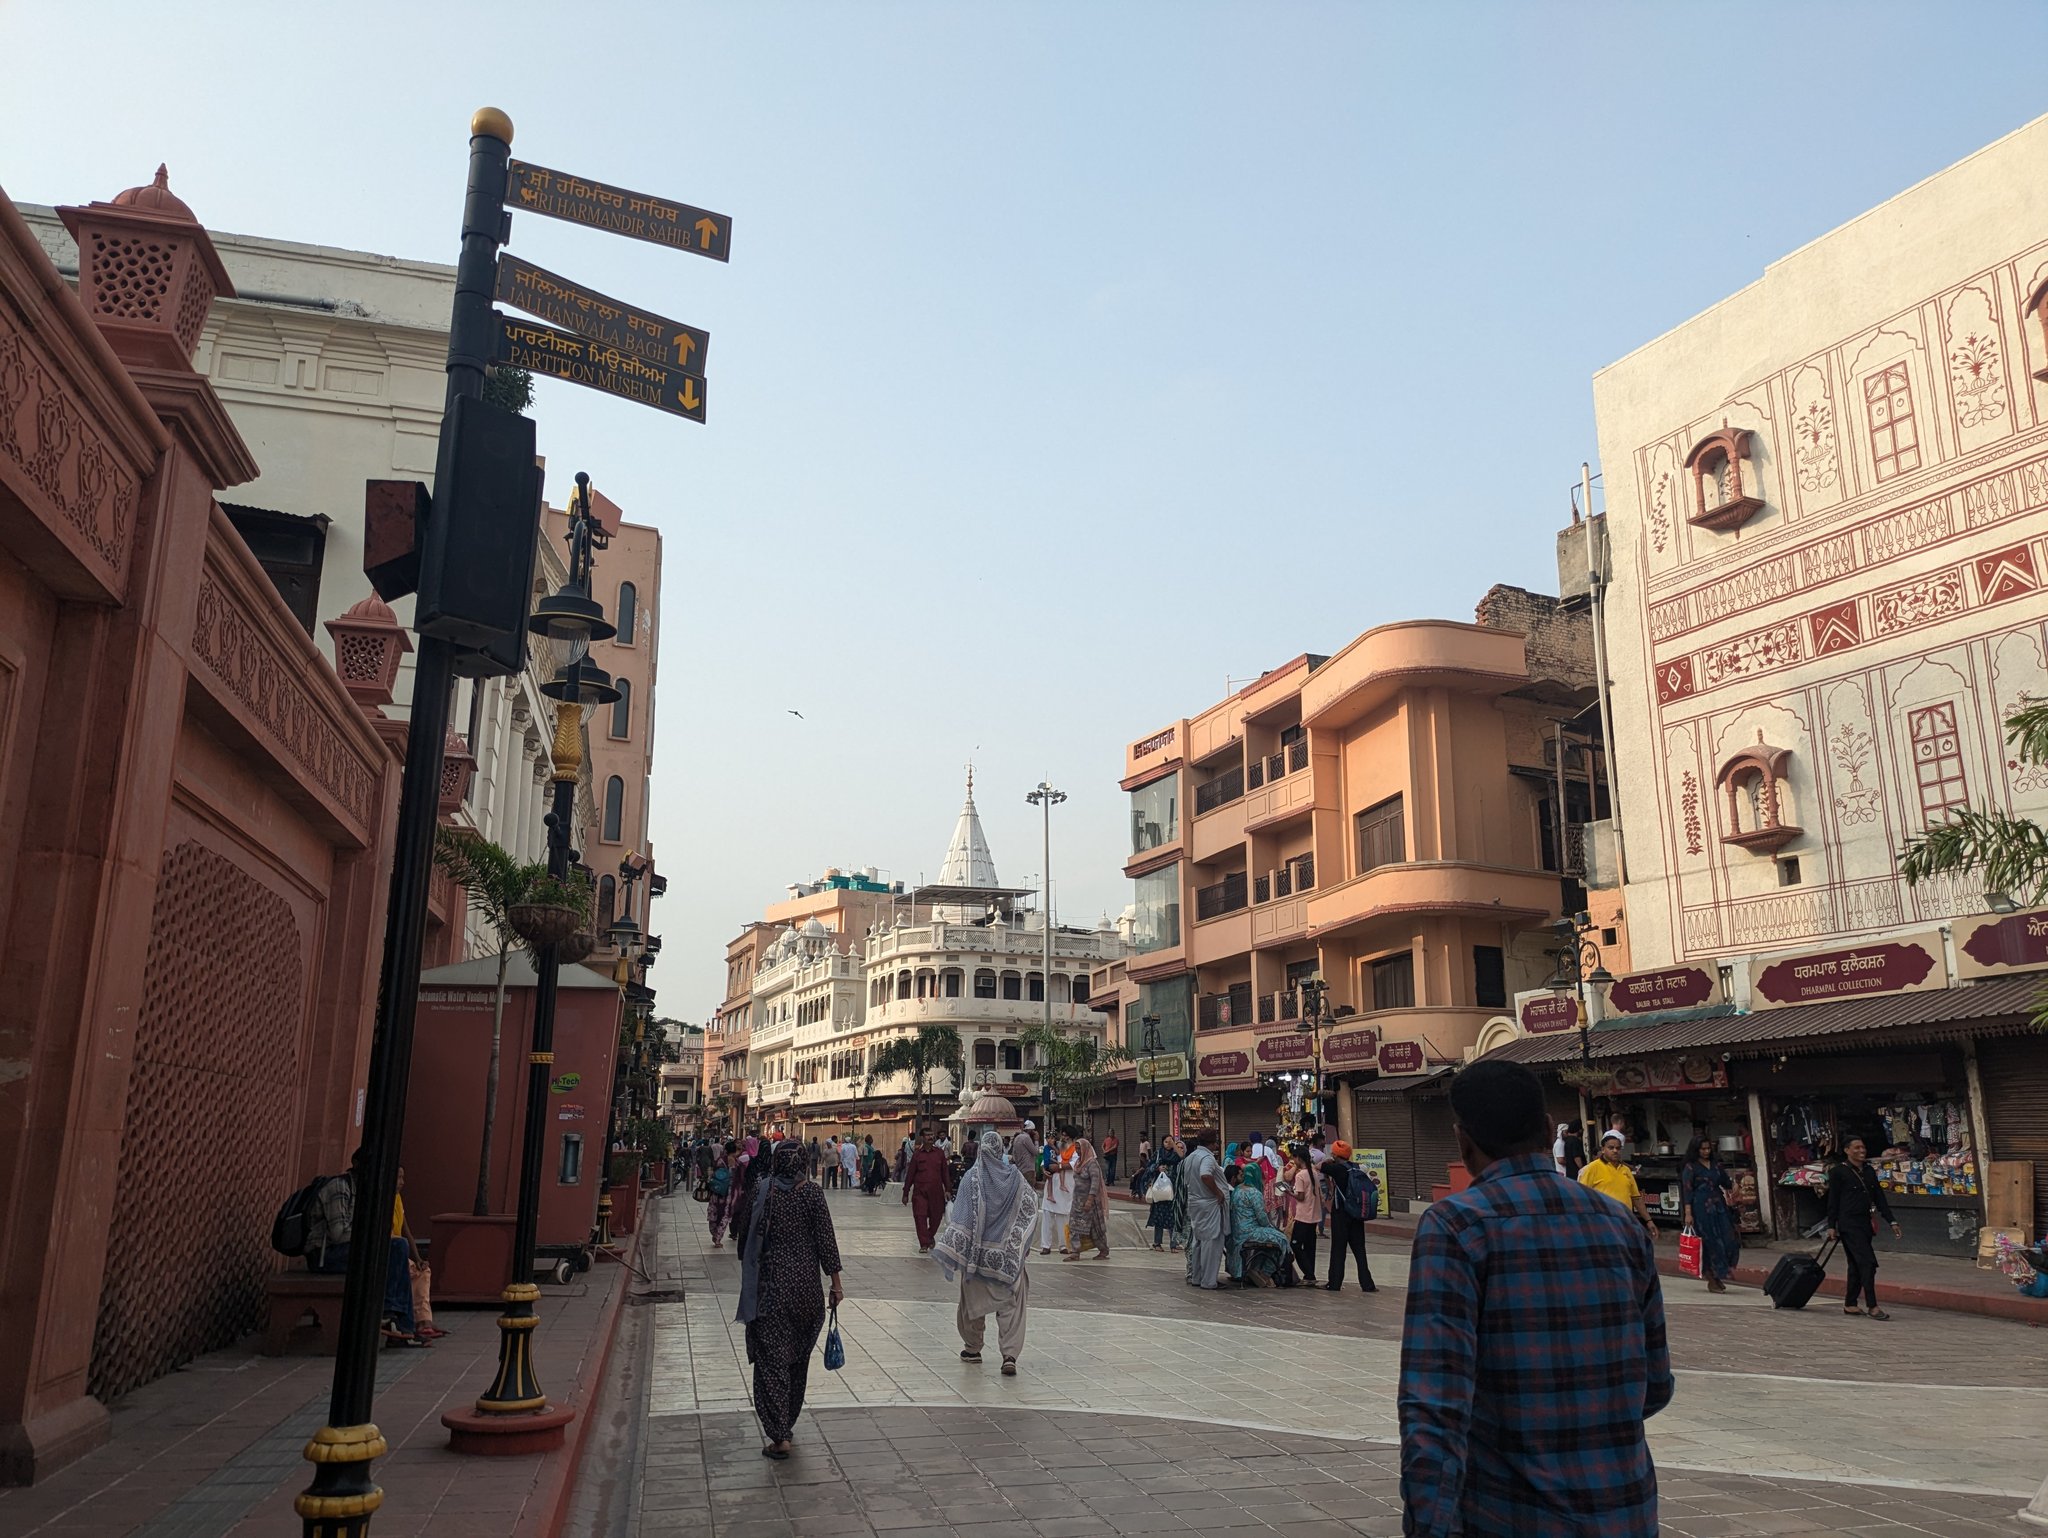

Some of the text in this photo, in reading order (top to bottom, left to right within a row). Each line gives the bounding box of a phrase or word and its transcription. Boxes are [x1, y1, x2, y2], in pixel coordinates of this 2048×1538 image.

[557, 178, 625, 209] ਹਰਿਮੰਦਰ
[629, 199, 680, 223] ਸਾਹਿਬ
[557, 197, 645, 235] HARMANDIR
[649, 222, 691, 246] SAHIB
[508, 287, 668, 362] JALLIANWALA BAGH
[627, 314, 664, 339] ਬਾਗ
[505, 325, 584, 357] ਪਾਰਟੀਸ਼ਨ
[510, 346, 662, 404] PARTITION MUSEUM
[1793, 961, 1837, 979] ਧਰਮਪਾਲ
[1654, 976, 1664, 991] ਟੀ
[1801, 977, 1882, 996] DHARMPAL COLLECTION
[447, 991, 466, 1002] Water
[1636, 1000, 1651, 1008] BALBIR
[1662, 997, 1675, 1005] STALL
[552, 1077, 580, 1085] Hi-Tech
